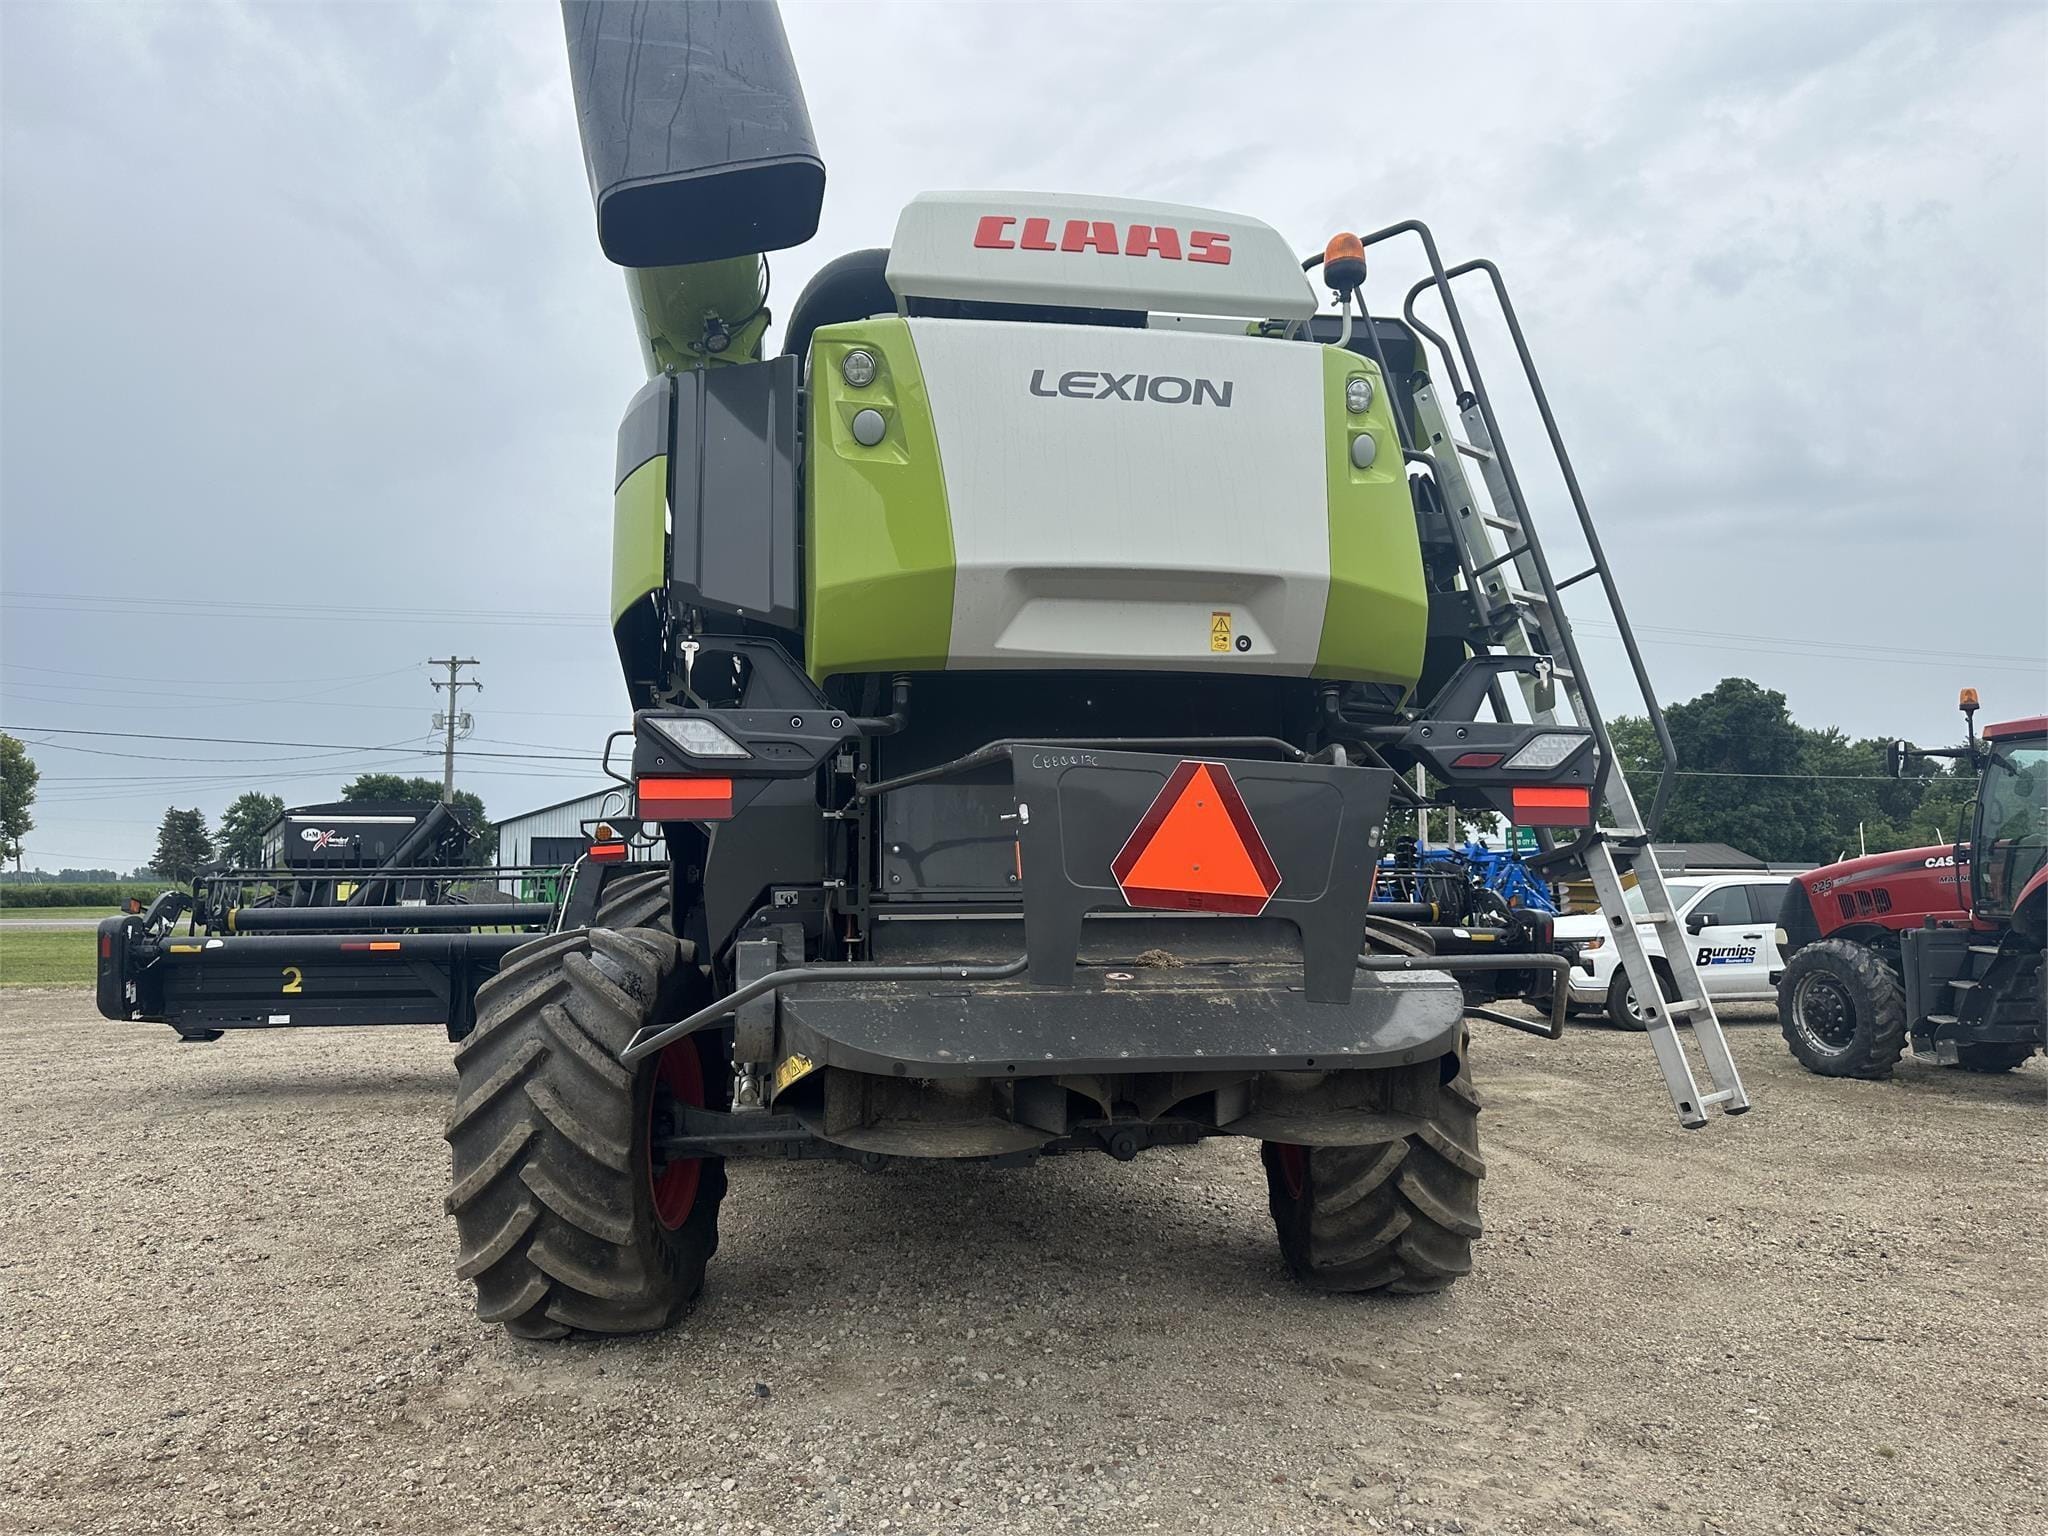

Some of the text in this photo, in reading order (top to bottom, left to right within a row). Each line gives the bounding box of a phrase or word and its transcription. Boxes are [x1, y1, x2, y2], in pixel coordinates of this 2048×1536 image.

[974, 216, 1231, 265] CLAAS
[1029, 369, 1233, 408] LEXION
[1811, 878, 1832, 894] 225
[1696, 944, 1756, 966] Burnips
